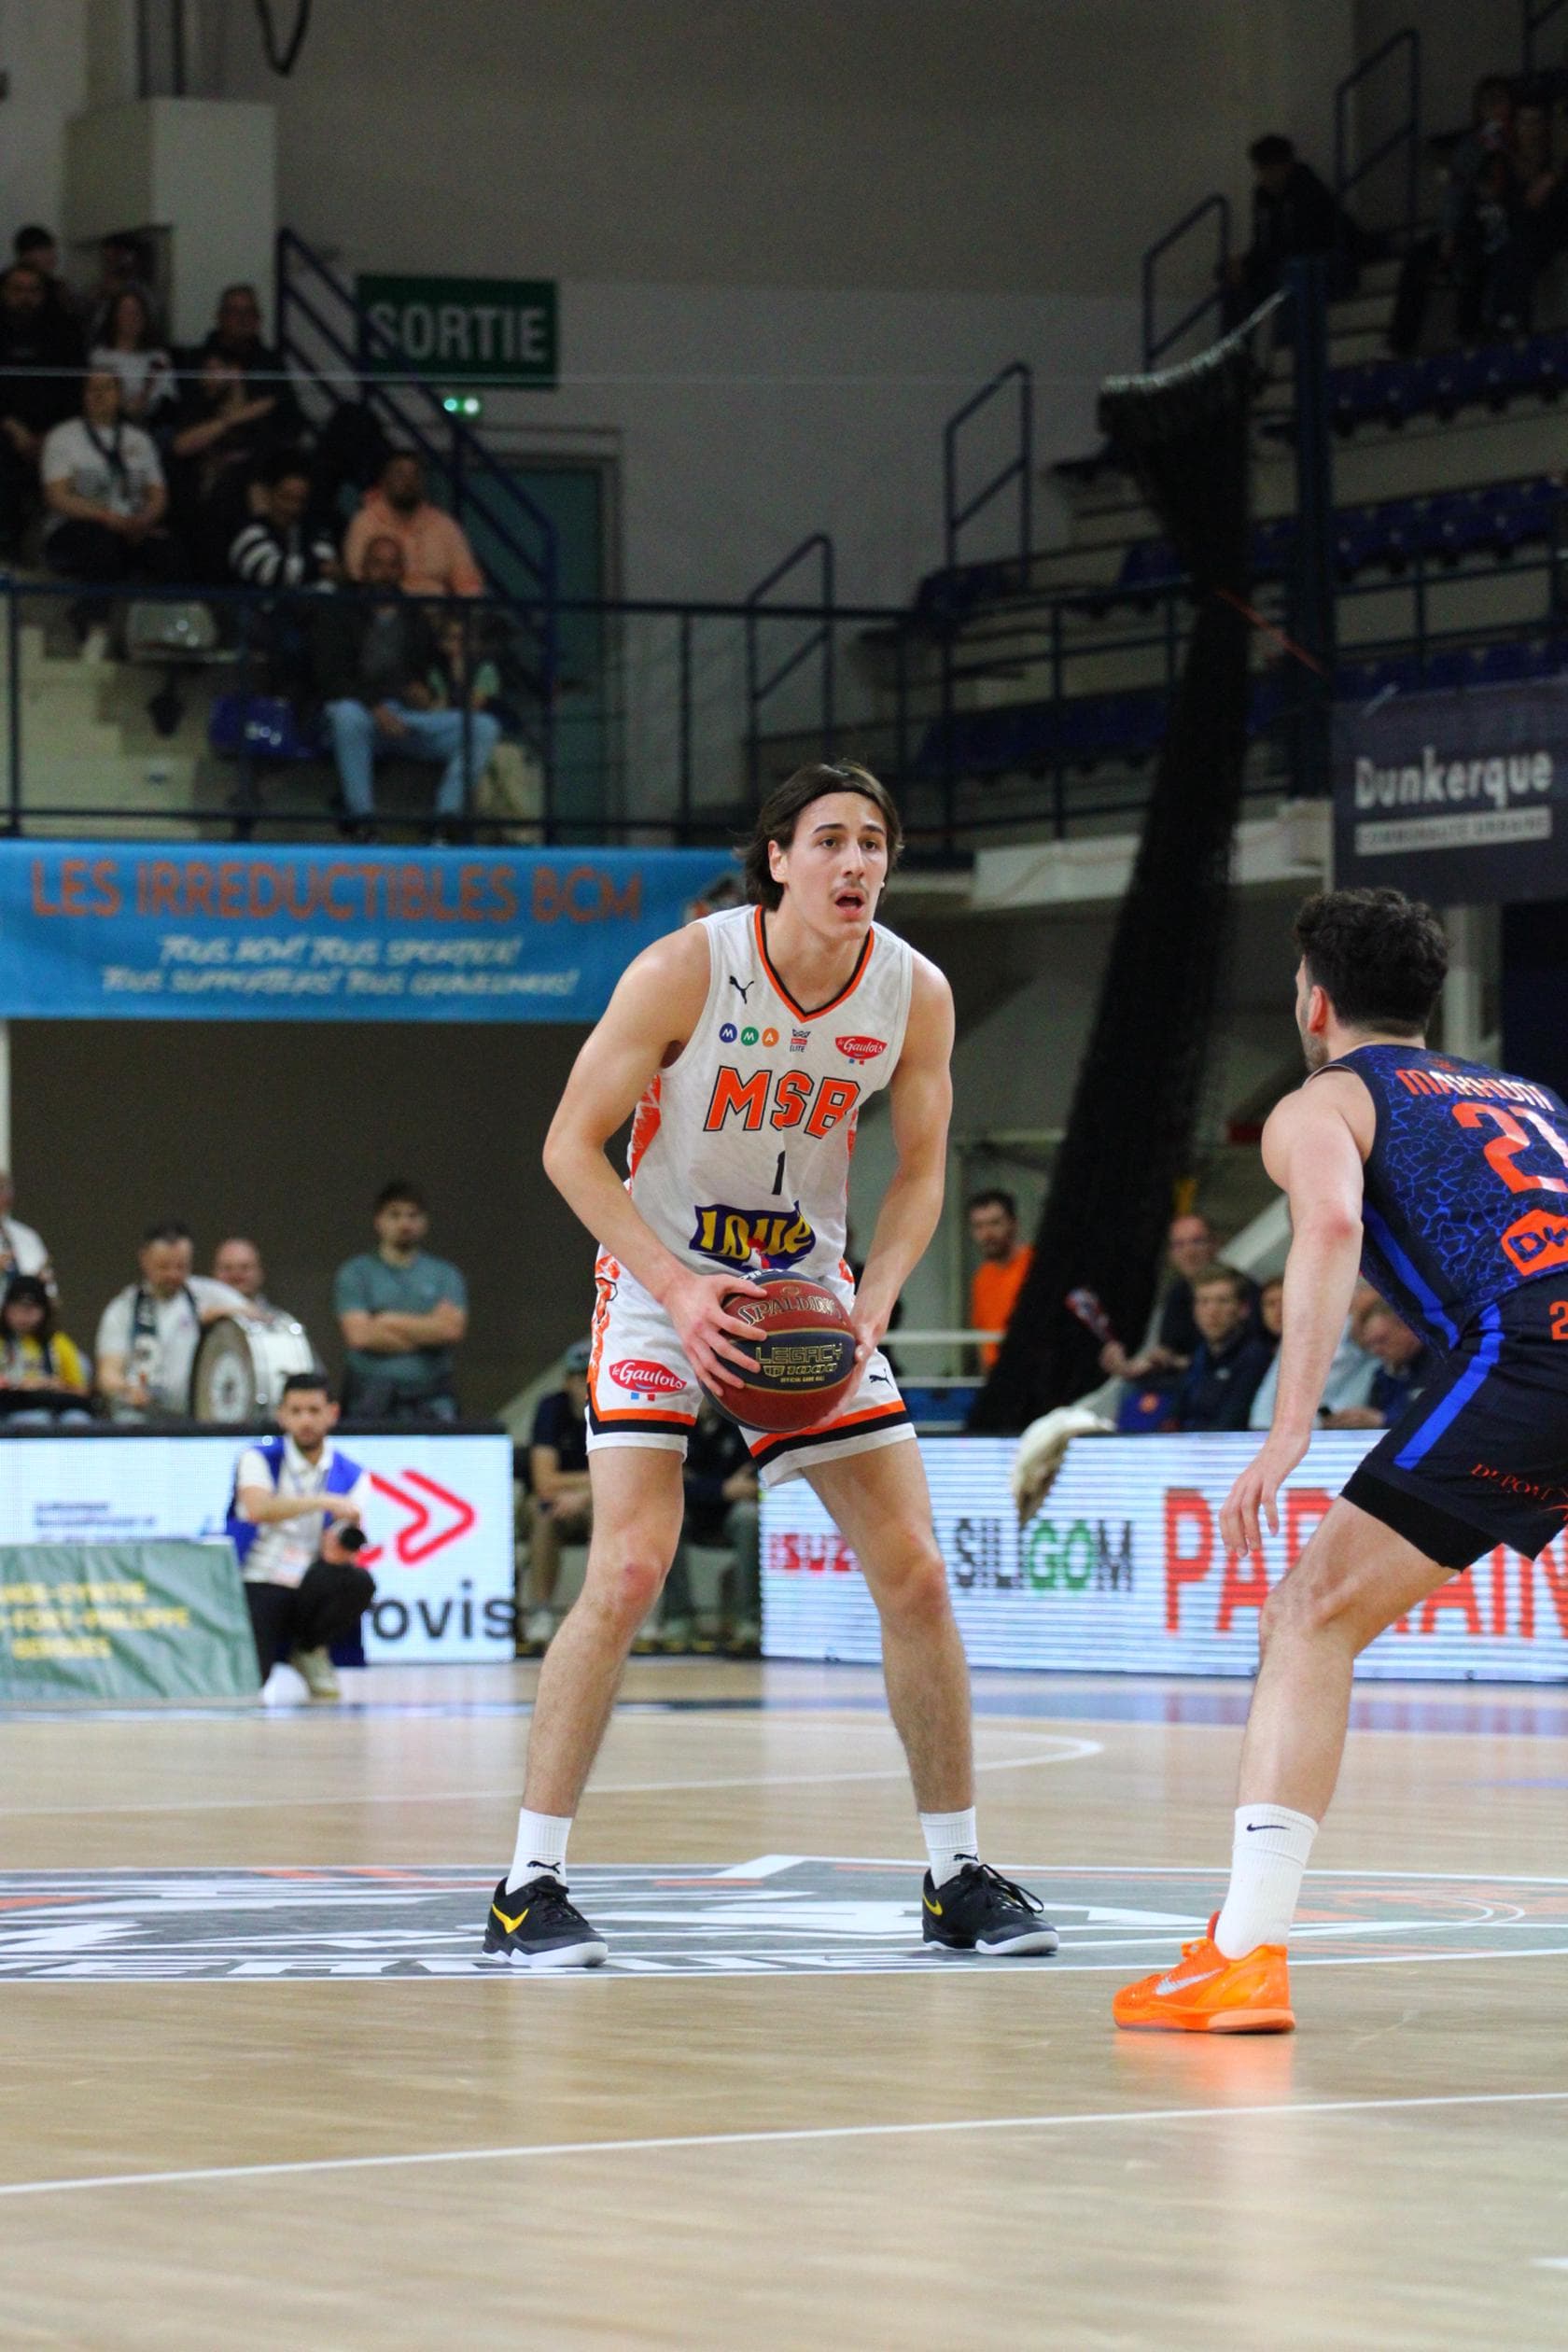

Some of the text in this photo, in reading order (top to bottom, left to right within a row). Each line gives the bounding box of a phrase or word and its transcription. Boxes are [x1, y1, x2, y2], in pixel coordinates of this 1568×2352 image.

[370, 304, 546, 362] SORTIE
[1356, 747, 1553, 809] Dunkerque
[32, 860, 642, 923] LES IRREDUCTIBLES BCM
[844, 1037, 884, 1054] Gaulois
[703, 1065, 861, 1140] MSB
[771, 1150, 786, 1196] 1
[1452, 1101, 1568, 1194] 21
[738, 1295, 842, 1325] SPALDIN
[620, 1362, 683, 1390] Gaulois
[755, 1342, 843, 1364] LEGACY
[956, 1518, 1134, 1592] SILIGOM
